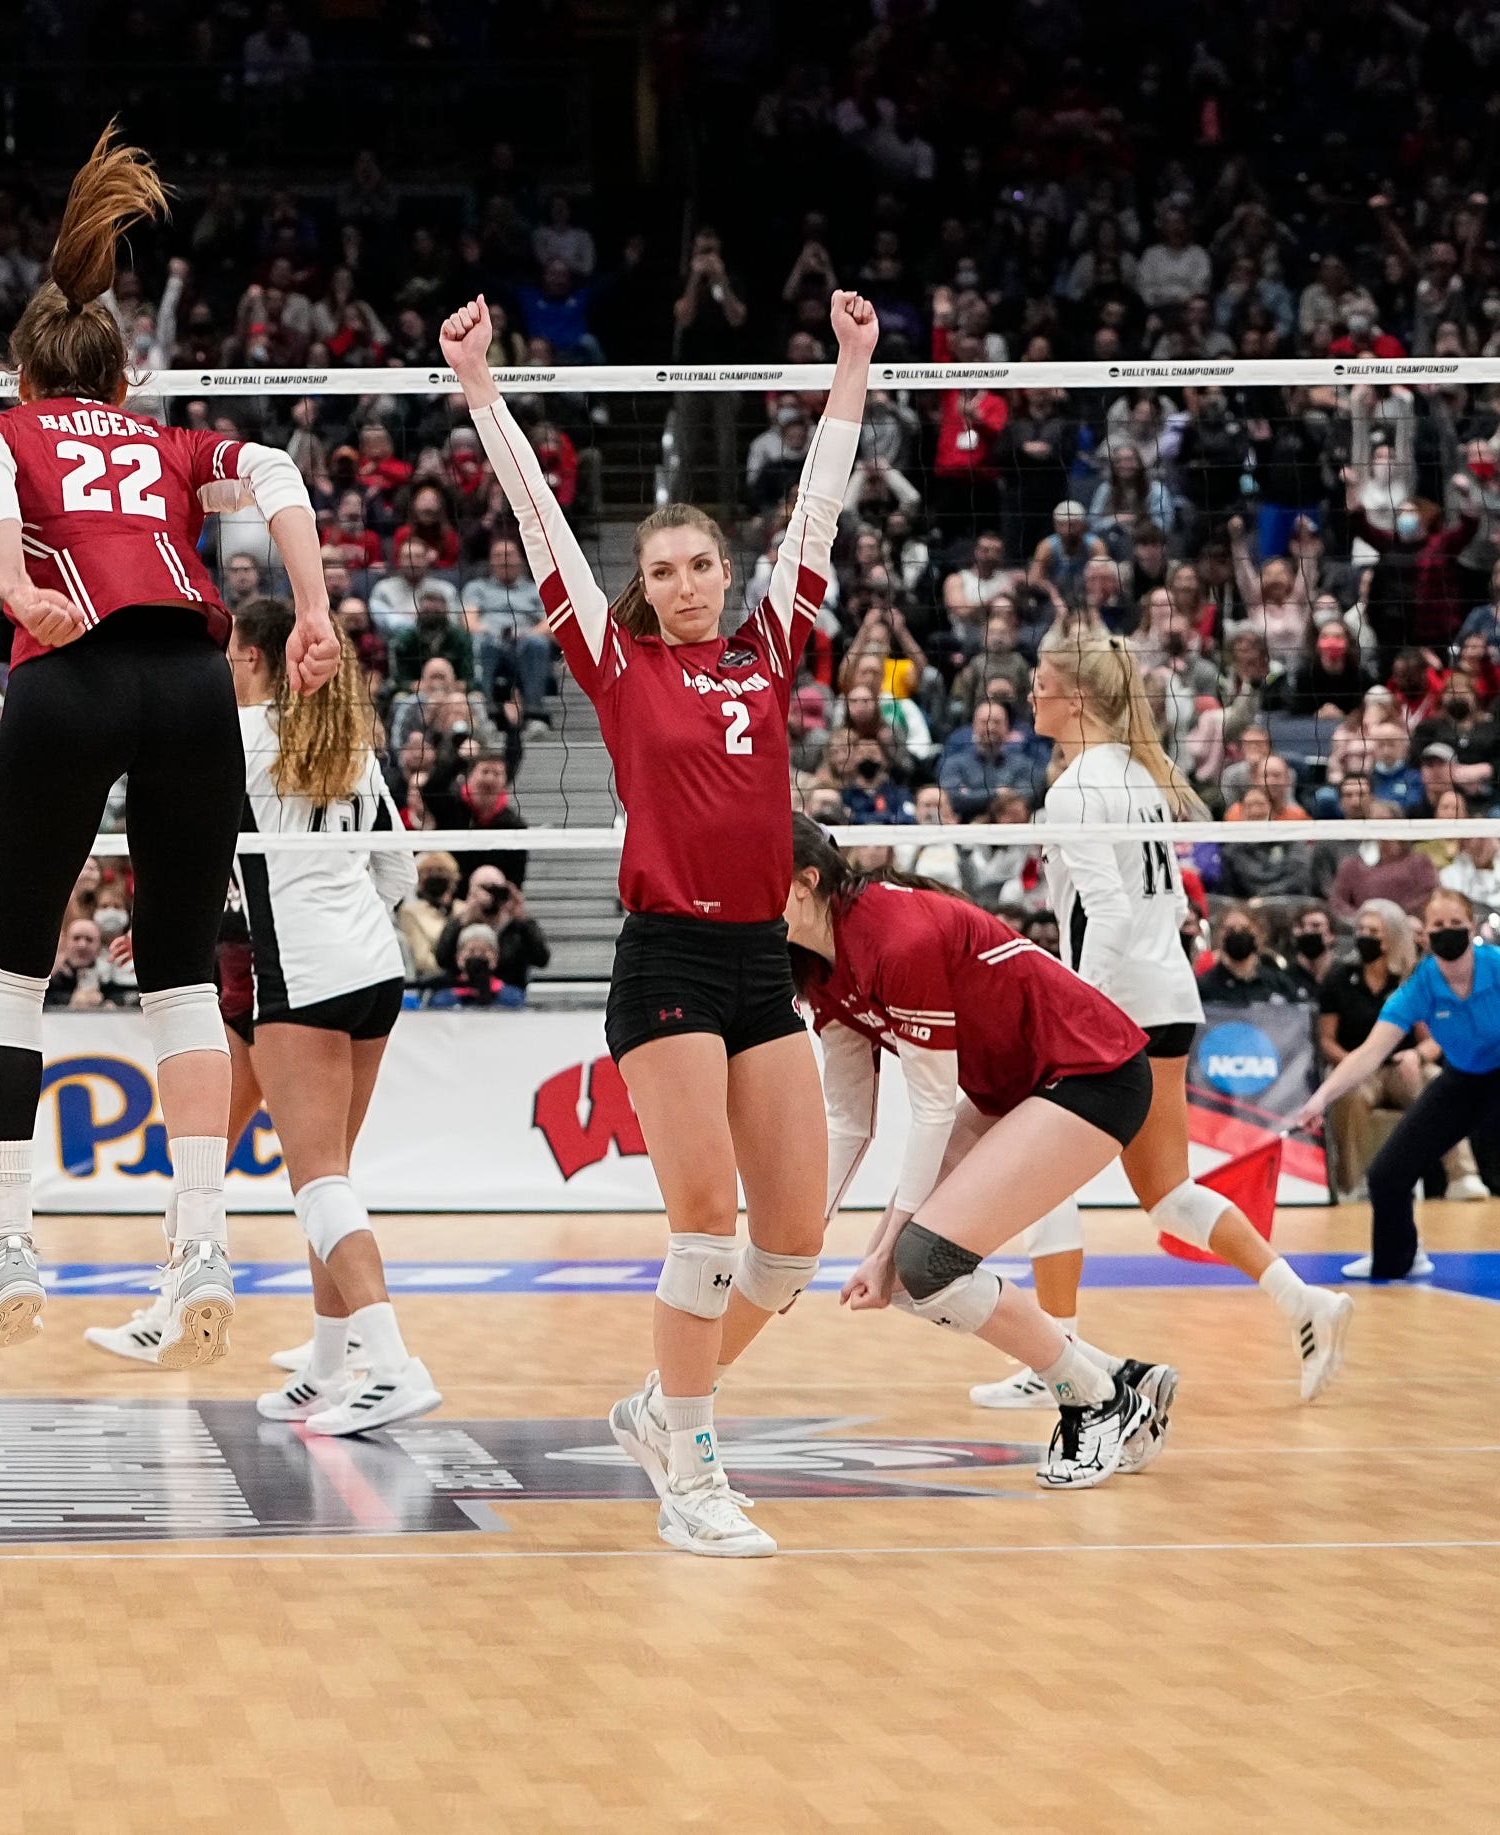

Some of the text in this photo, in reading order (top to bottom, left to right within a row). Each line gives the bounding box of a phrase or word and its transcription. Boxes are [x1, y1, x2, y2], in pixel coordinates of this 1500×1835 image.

[895, 369, 1009, 380] VOLLEYBALL CHAMPIONSHIP
[1121, 367, 1234, 377] VOLLEYBALL CHAMPIONSHIP
[1346, 365, 1459, 375] VOLLEYBALL CHAMPIONSHIP
[213, 375, 328, 386] VOLLEYBALL CHAMPIONSHIP
[492, 374, 555, 384] CHAMPIONSHIP
[669, 371, 783, 382] VOLLEYBALL CHAMPIONSHIP
[37, 409, 160, 438] BADGERS
[56, 440, 167, 521] 22
[721, 701, 753, 755] 2
[1208, 1056, 1278, 1078] NCAA
